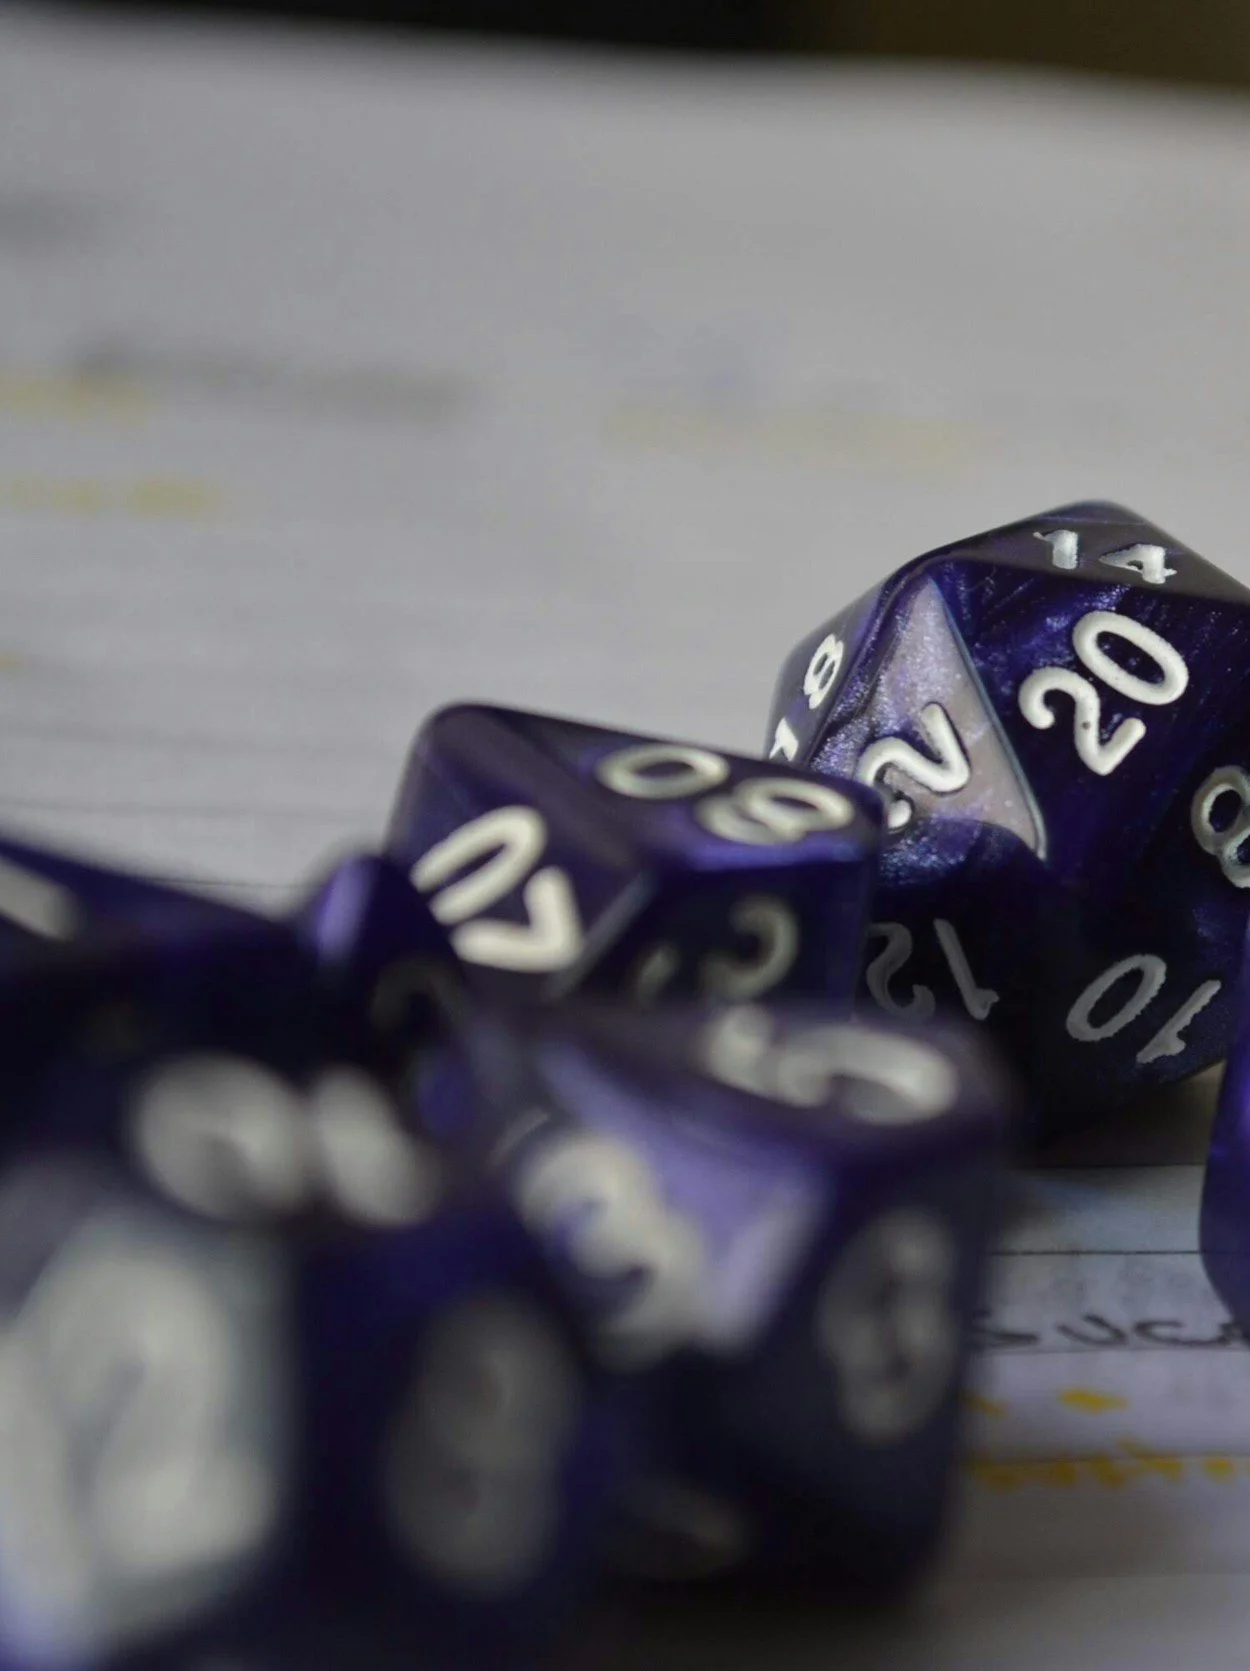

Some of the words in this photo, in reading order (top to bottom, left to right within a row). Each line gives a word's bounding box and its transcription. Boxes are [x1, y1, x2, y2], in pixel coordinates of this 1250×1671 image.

[1033, 530, 1177, 584] 14
[1018, 610, 1189, 775] 20
[597, 743, 855, 846] 80
[1065, 953, 1222, 1066] 10
